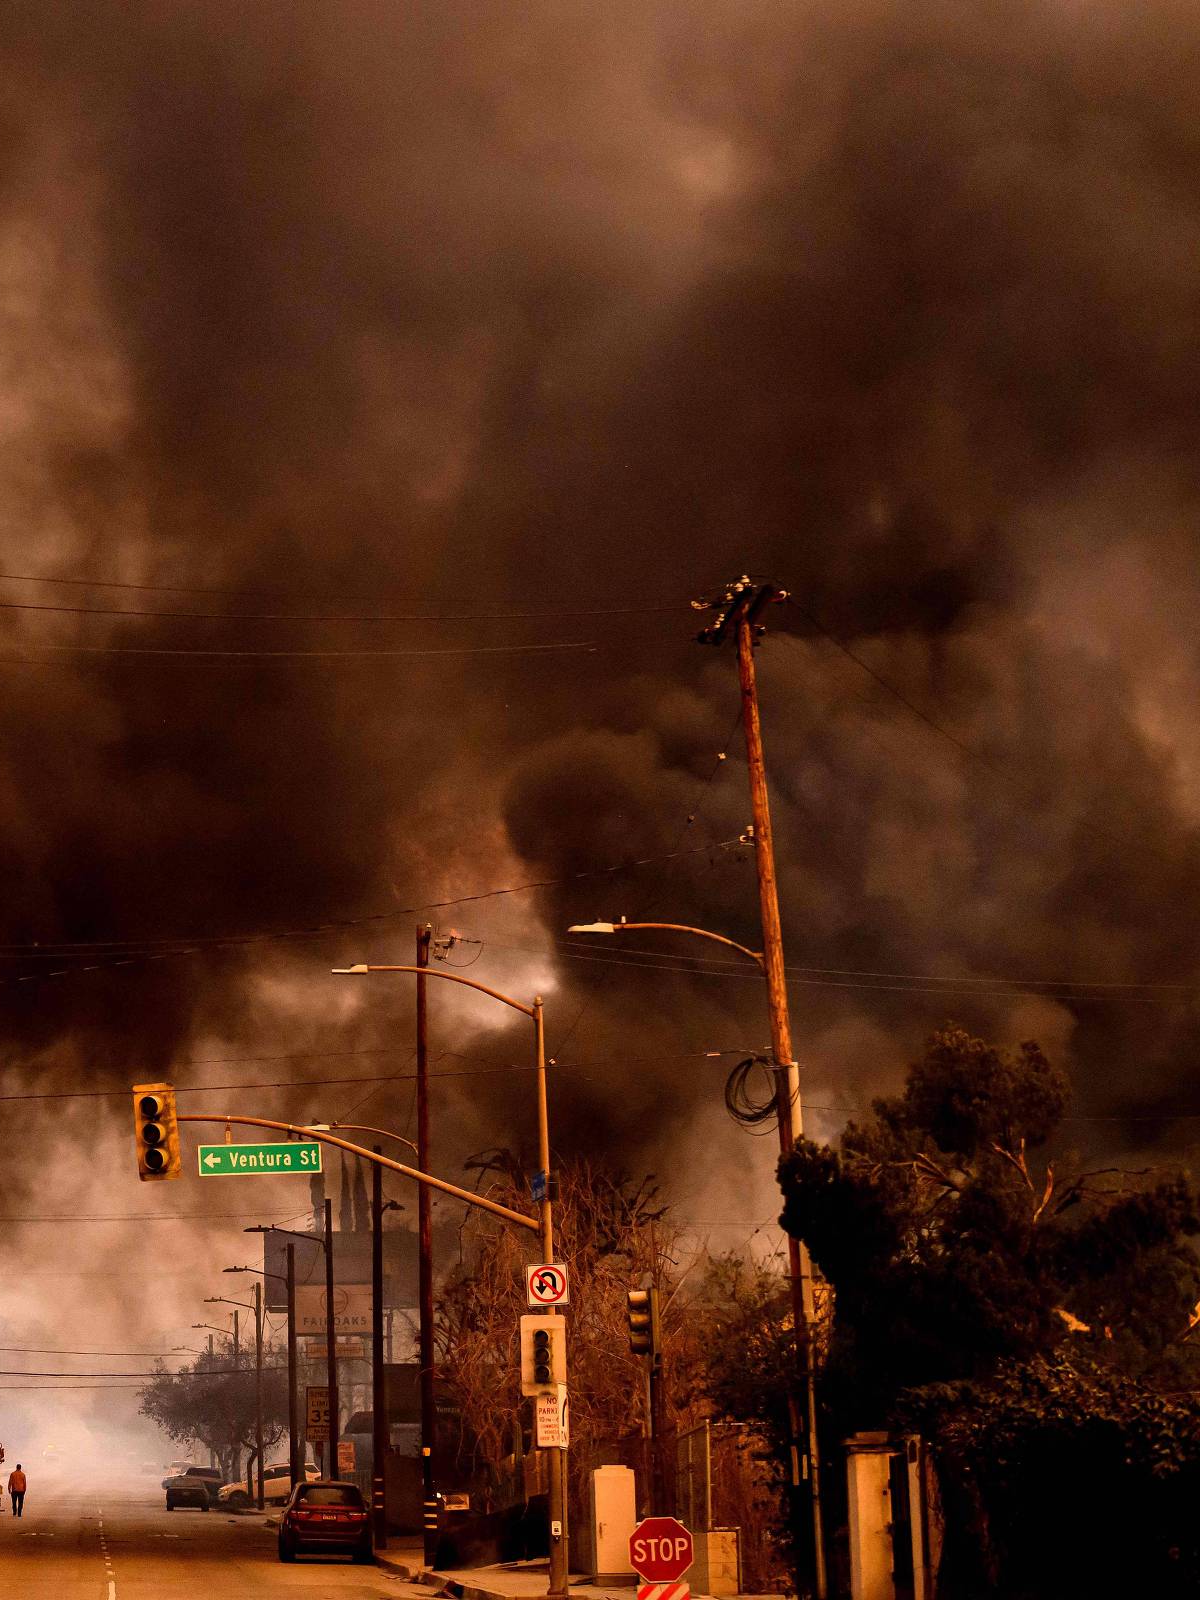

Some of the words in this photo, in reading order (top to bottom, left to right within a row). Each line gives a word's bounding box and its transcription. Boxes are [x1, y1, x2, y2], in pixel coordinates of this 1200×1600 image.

[229, 1151, 292, 1168] Ventura
[300, 1149, 317, 1165] St
[538, 1407, 558, 1415] PARKI
[633, 1537, 688, 1563] STOP
